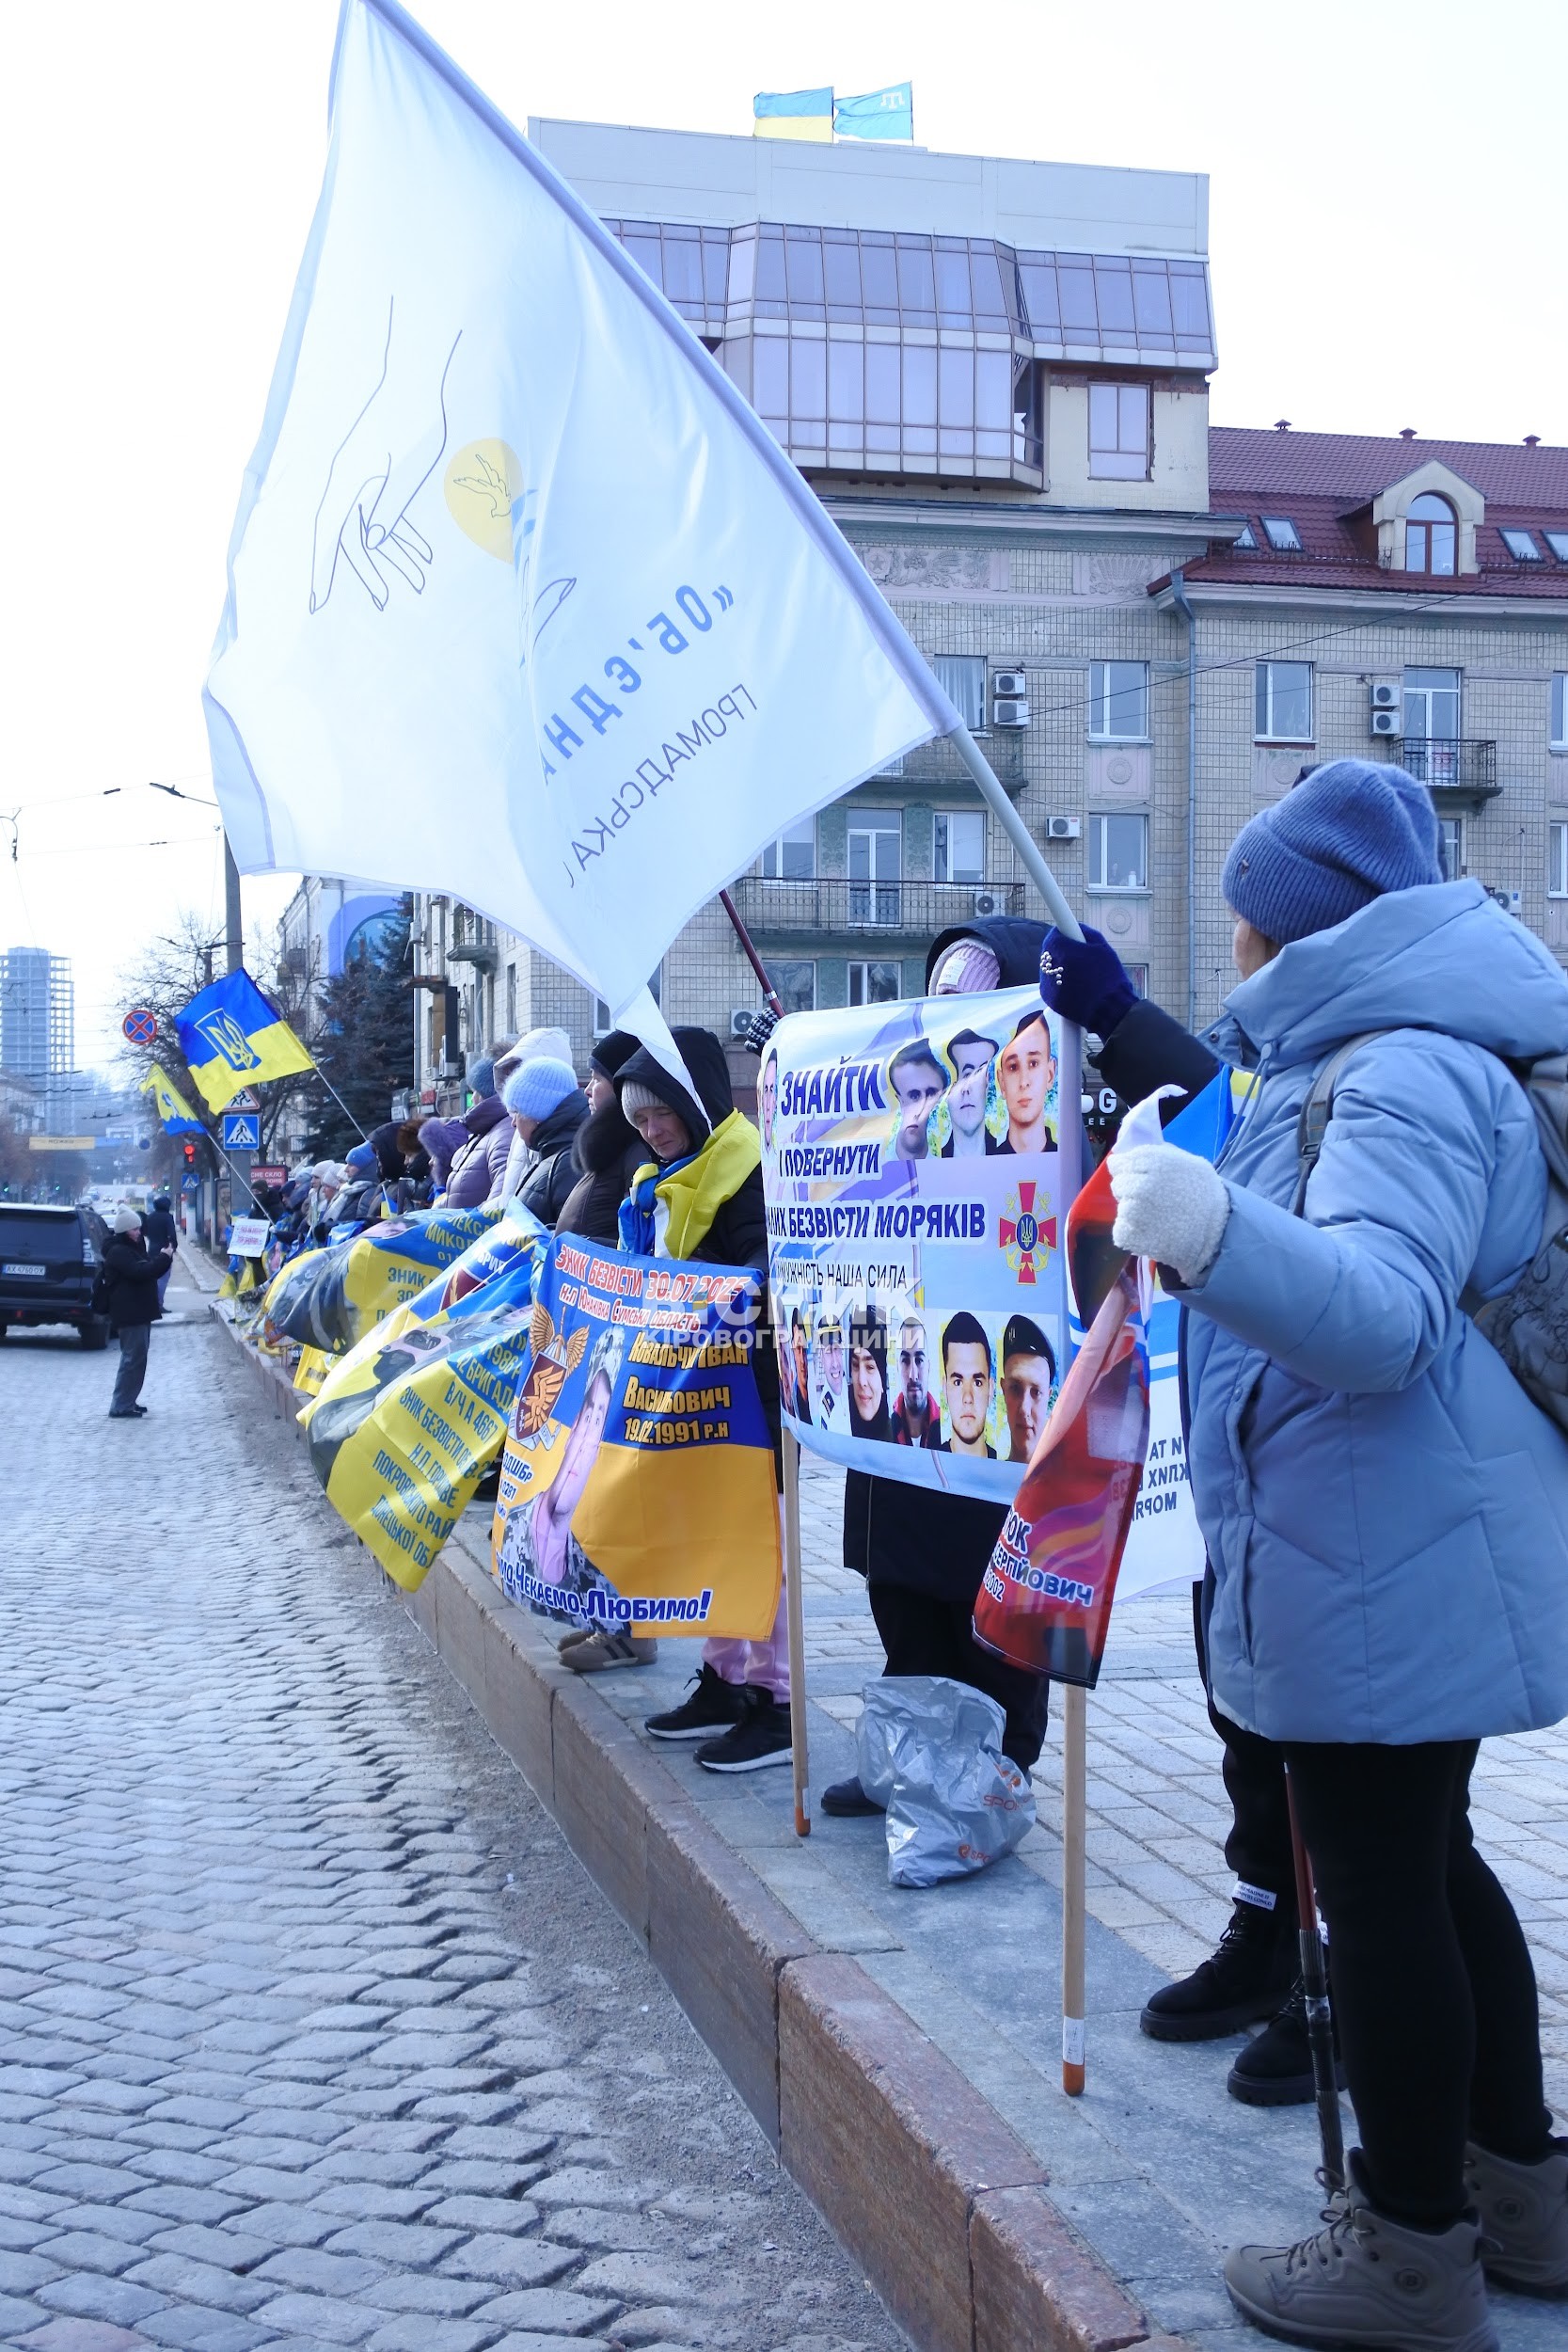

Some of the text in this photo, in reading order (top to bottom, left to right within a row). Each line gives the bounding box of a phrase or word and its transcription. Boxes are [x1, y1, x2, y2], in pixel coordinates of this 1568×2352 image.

[781, 1055, 887, 1117] ЗНАЙТИ
[784, 1143, 880, 1177] ПОВЕРНУТИ
[788, 1206, 870, 1238] БЕЗВІСТИ
[874, 1203, 987, 1238] МОРЯКІВ
[556, 1246, 752, 1305] ЗНИК БЕЗВІСТИ 30.07.2025
[826, 1263, 863, 1288] НАША
[867, 1264, 908, 1289] СИЛА
[399, 1386, 426, 1422] ЗНИК
[420, 1409, 466, 1461] БЕЗВІСТИ
[473, 1409, 499, 1445] 4667
[625, 1417, 701, 1445] 19.02.1991
[587, 1588, 713, 1622] ЛЮБИМО!
